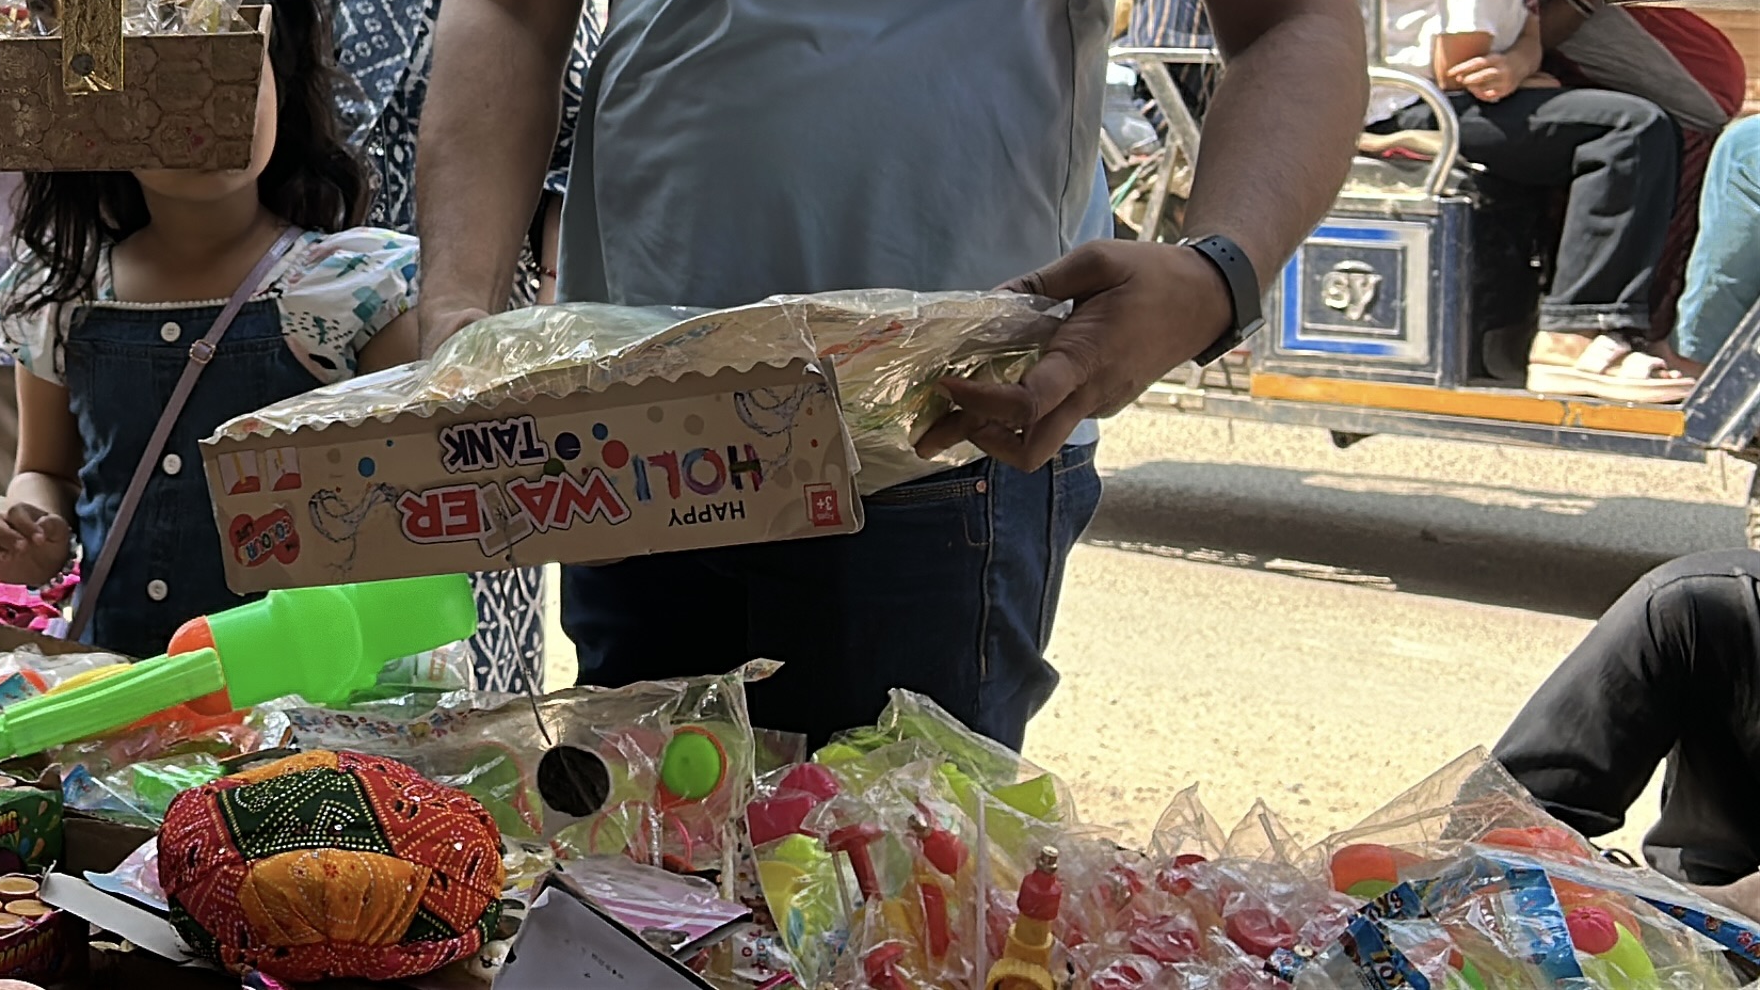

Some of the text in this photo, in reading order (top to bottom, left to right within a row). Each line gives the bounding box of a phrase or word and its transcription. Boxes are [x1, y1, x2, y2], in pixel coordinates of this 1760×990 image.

[439, 415, 549, 474] TANK
[631, 443, 763, 503] HOLI
[396, 468, 632, 557] WATER
[668, 500, 746, 527] HAPPY
[816, 495, 833, 511] 3+
